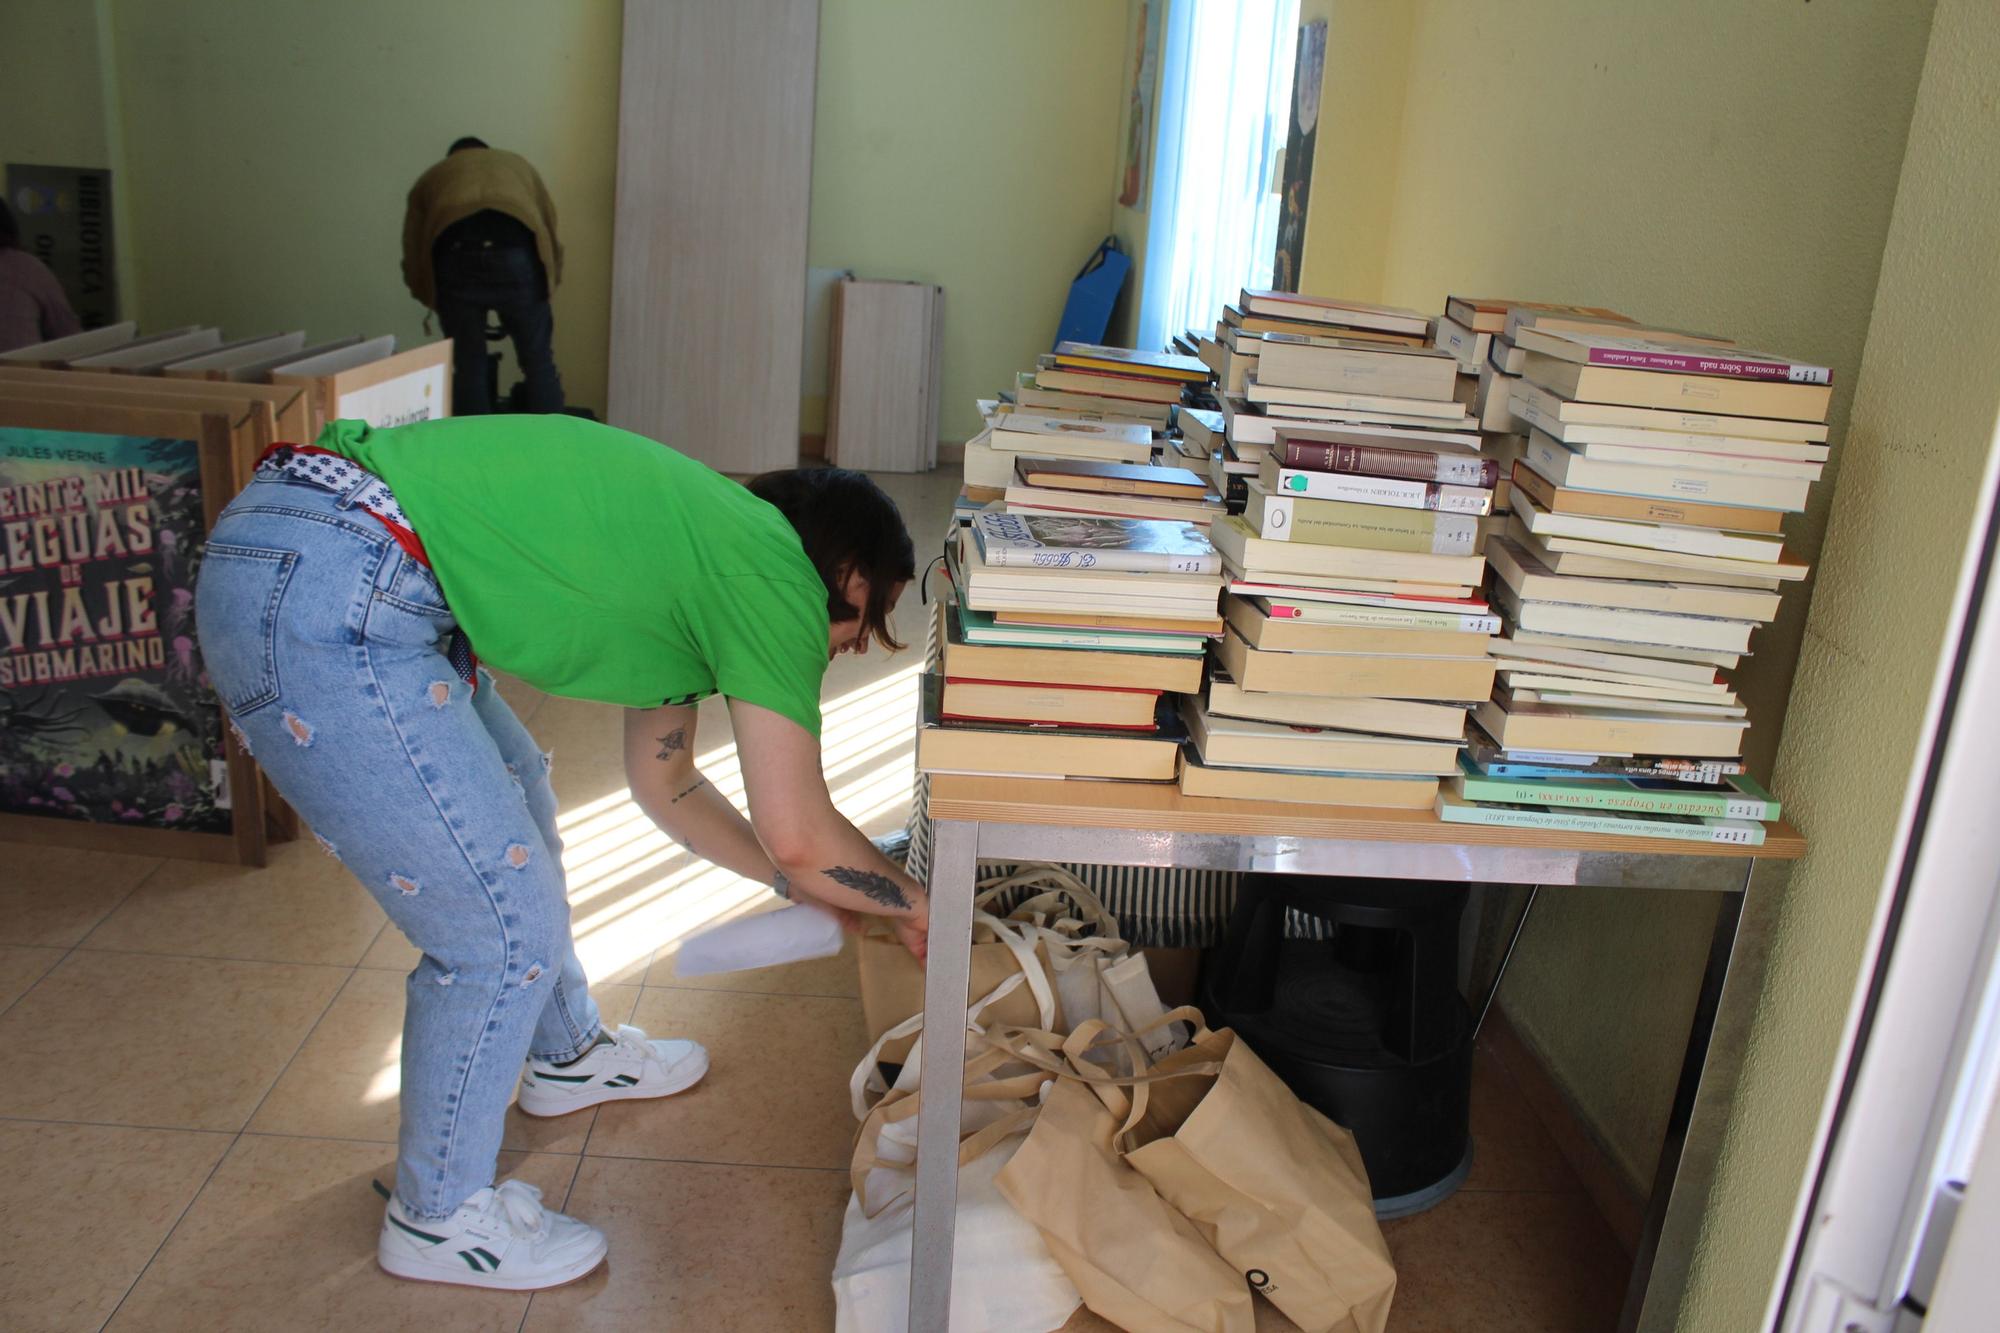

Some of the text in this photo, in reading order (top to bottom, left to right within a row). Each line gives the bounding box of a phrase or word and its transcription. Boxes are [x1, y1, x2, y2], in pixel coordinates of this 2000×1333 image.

[79, 175, 103, 295] BIBLIOTECA
[1699, 361, 1718, 371] nada
[1719, 362, 1742, 374] Sobre
[1745, 365, 1775, 375] nosotras
[6, 446, 108, 464] JULES VERNE
[95, 467, 153, 505] MIL
[1371, 488, 1401, 497] TOLKIEN
[1032, 551, 1097, 568] El Hobbit
[60, 564, 82, 588] DE
[0, 576, 159, 654] VIAJE
[0, 637, 166, 689] SUBMARINO
[1659, 769, 1680, 777] temps
[1607, 797, 1655, 810] Oropesa
[1677, 804, 1724, 815] Sucedió
[1516, 816, 1543, 825] Oropesa
